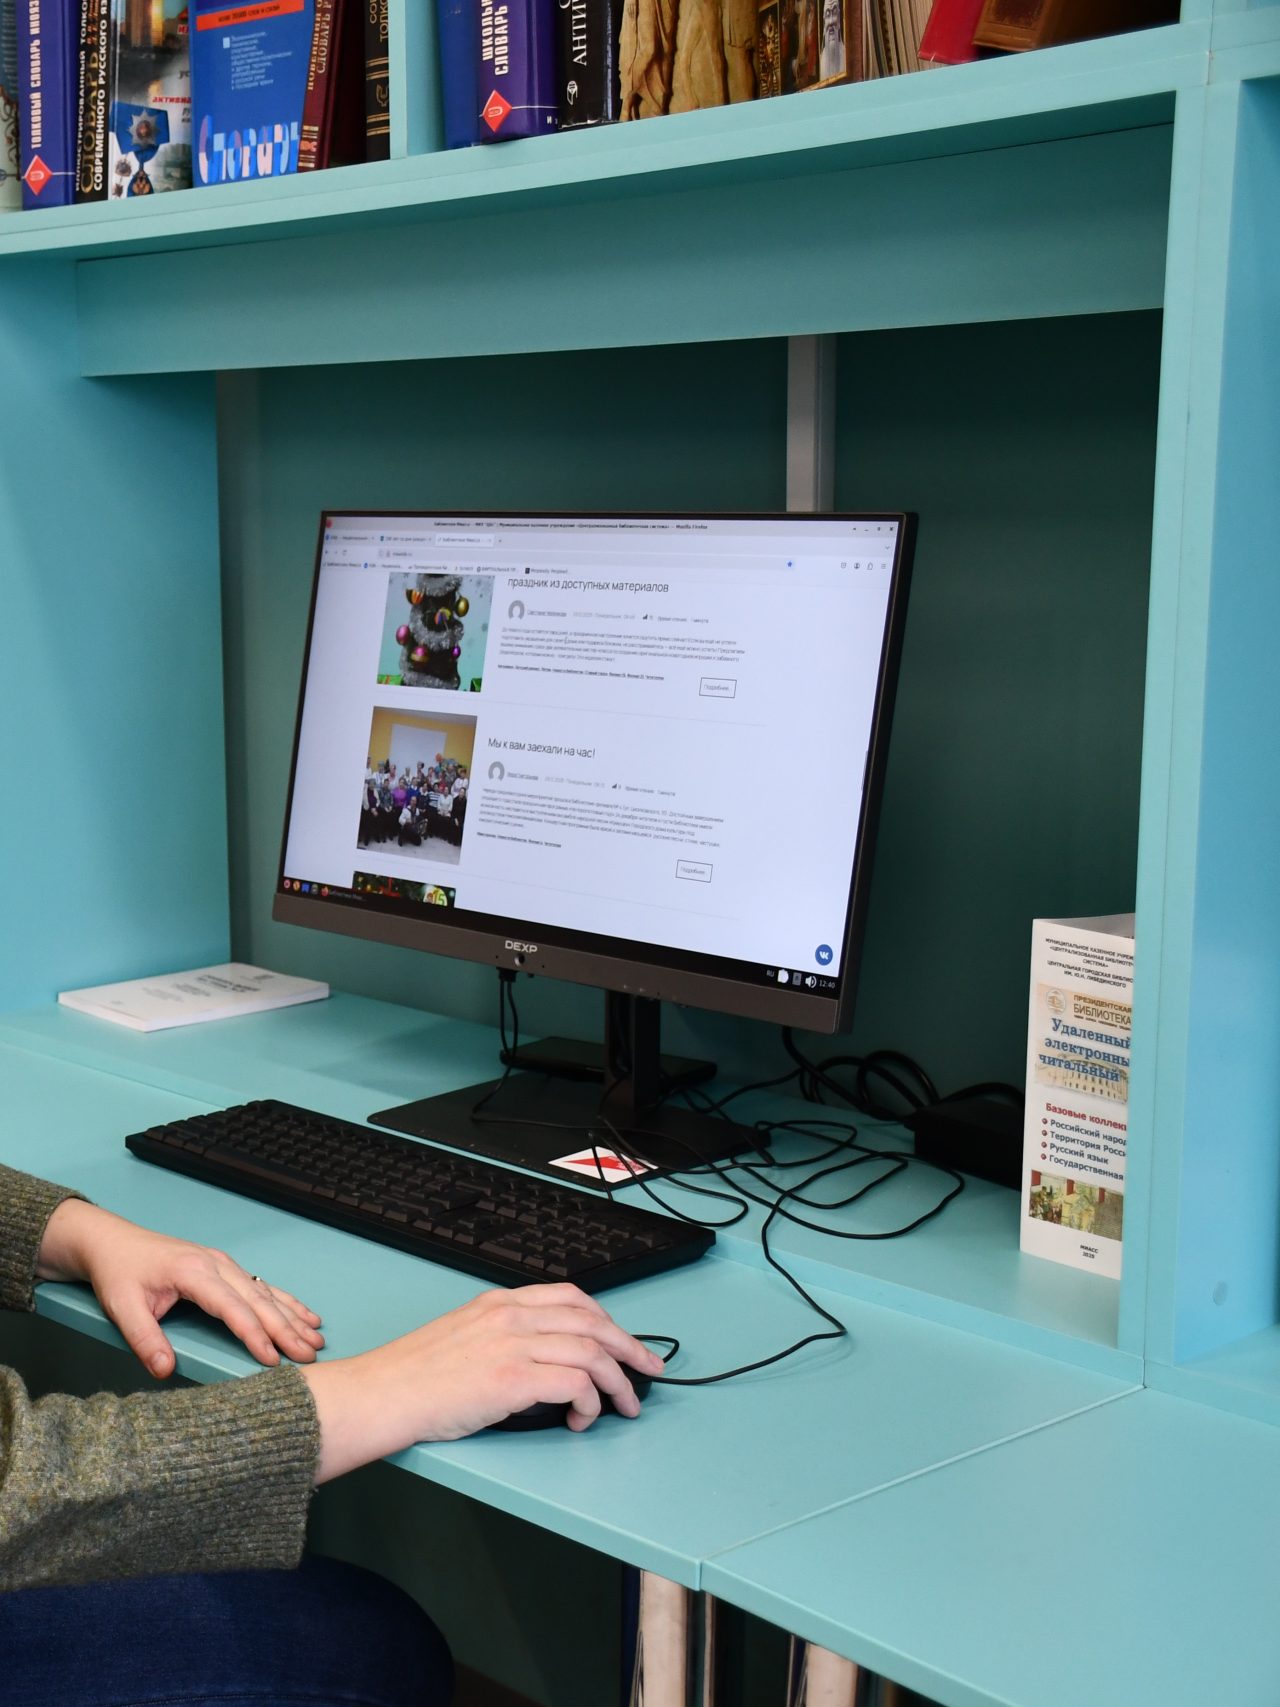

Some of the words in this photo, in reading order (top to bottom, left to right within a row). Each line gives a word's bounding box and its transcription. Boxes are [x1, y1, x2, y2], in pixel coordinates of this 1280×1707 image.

[80, 0, 88, 45] ТОЛКО
[572, 0, 587, 66] АНТИ
[98, 19, 108, 85] РУССКОГО
[317, 13, 332, 74] СЛОВАРЬ
[494, 5, 509, 76] СЛОВАРЬ
[29, 39, 42, 88] СЛОВАРЬ
[29, 92, 42, 150] ТОЛКОВЫЙ
[75, 50, 86, 192] ИЛЛЮСТРИРОВАННЫЙ
[80, 51, 99, 194] СЛОВАРЬ
[93, 89, 106, 192] СОВРЕМЕННОГО
[507, 578, 549, 590] праздник
[550, 579, 561, 589] из
[561, 580, 610, 592] доступных
[611, 582, 669, 593] материалов
[487, 738, 502, 748] Мы
[503, 740, 508, 749] к
[509, 741, 526, 751] вам
[526, 743, 563, 755] заехали
[563, 747, 575, 757] на
[576, 747, 596, 759] час!
[504, 940, 538, 953] DEXP
[1045, 938, 1089, 951] МУНИЦИПАЛЬНОЕ
[1090, 947, 1115, 956] КАЗЕННОЕ
[1047, 960, 1081, 972] ЦЕНТРАЛЬНАЯ
[1081, 967, 1111, 978] ГОРОДСКАЯ
[1086, 975, 1127, 989] ЛИБЕДИНСКОГО
[1073, 994, 1132, 1013] ПРЕЗИДЕНТСКАЯ
[1073, 1003, 1132, 1025] БИБЛИОТЕКА
[1051, 1017, 1131, 1049] Удаленный
[1038, 1053, 1120, 1082] читальный
[1045, 1103, 1087, 1121] Базовые
[1050, 1119, 1100, 1138] Российский
[1050, 1131, 1101, 1150] Территория
[1049, 1142, 1085, 1158] Русский
[1086, 1153, 1109, 1165] язык
[1049, 1154, 1124, 1181] Государственная
